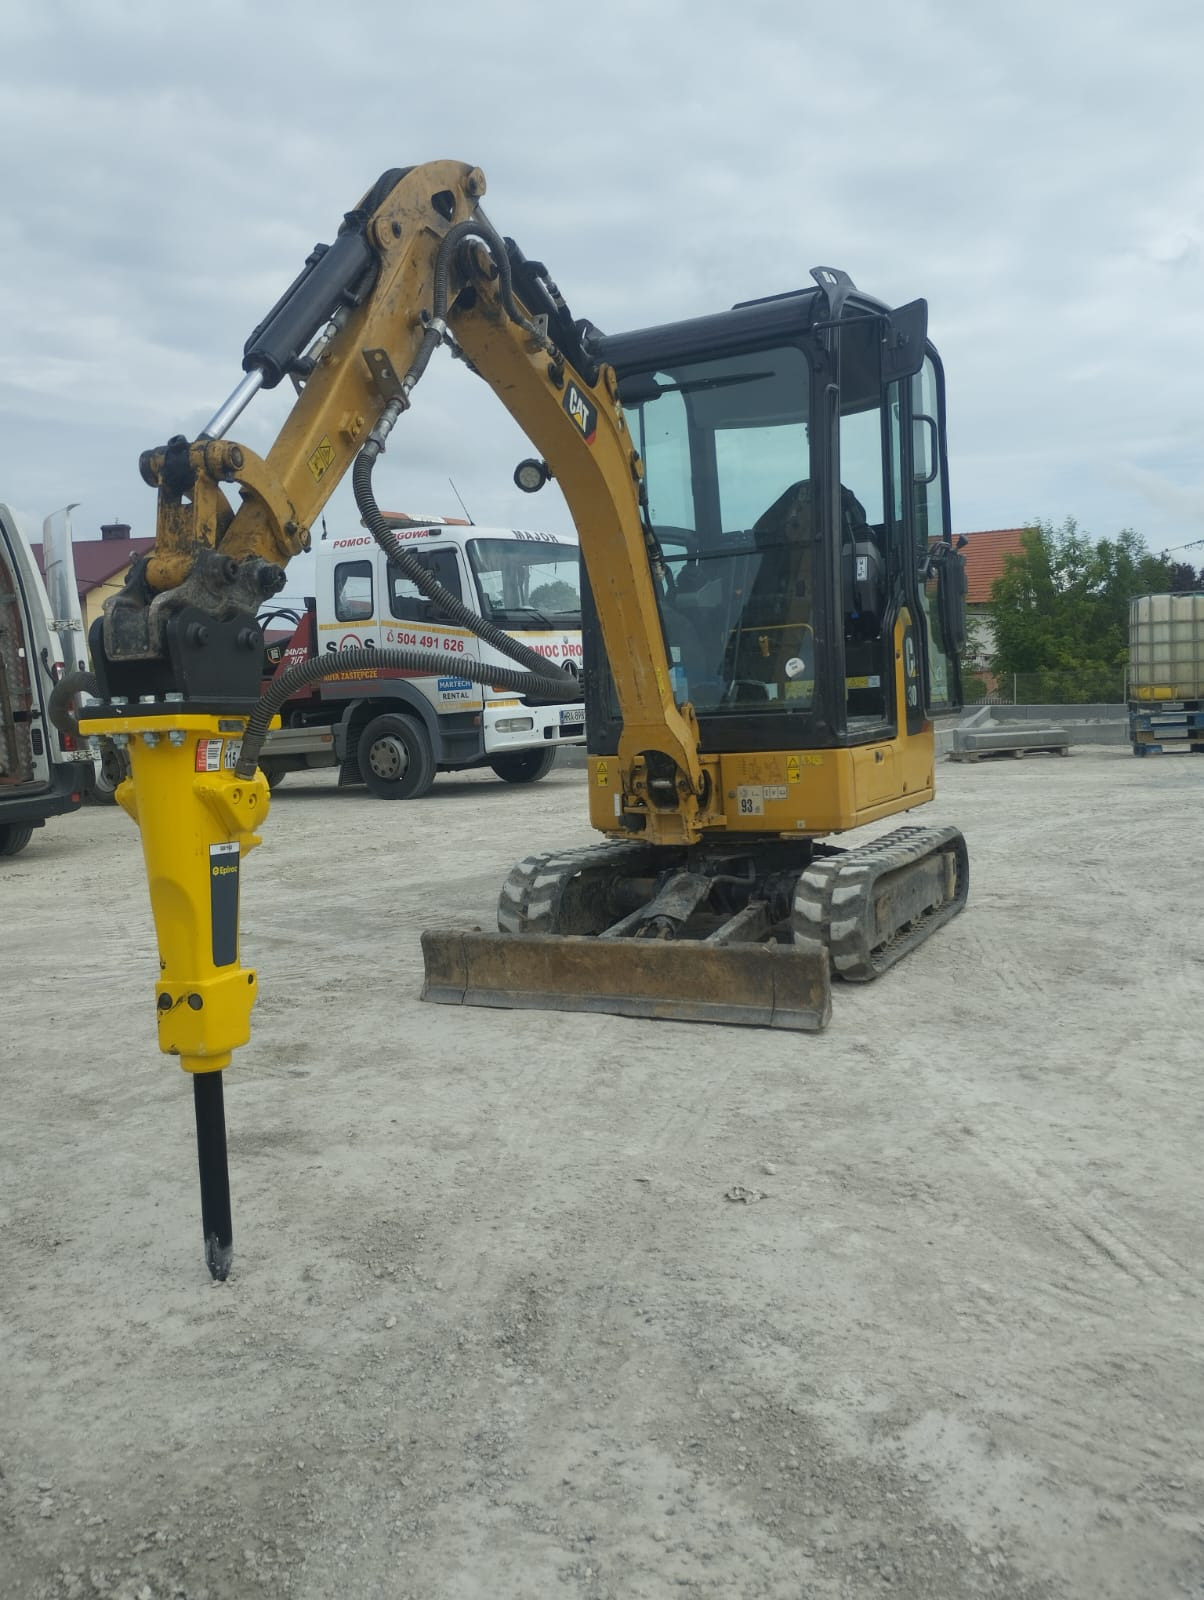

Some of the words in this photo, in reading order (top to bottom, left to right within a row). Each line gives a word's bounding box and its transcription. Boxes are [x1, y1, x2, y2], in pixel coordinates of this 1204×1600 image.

[569, 387, 589, 433] CAT
[333, 536, 371, 549] POMOC
[393, 530, 429, 540] GOWA
[512, 530, 560, 544] MAJOR
[397, 632, 416, 646] 504
[419, 635, 440, 649] 491
[443, 639, 464, 653] 626
[561, 644, 583, 657] DRO
[442, 692, 469, 700] RENTAL
[741, 799, 753, 813] 93
